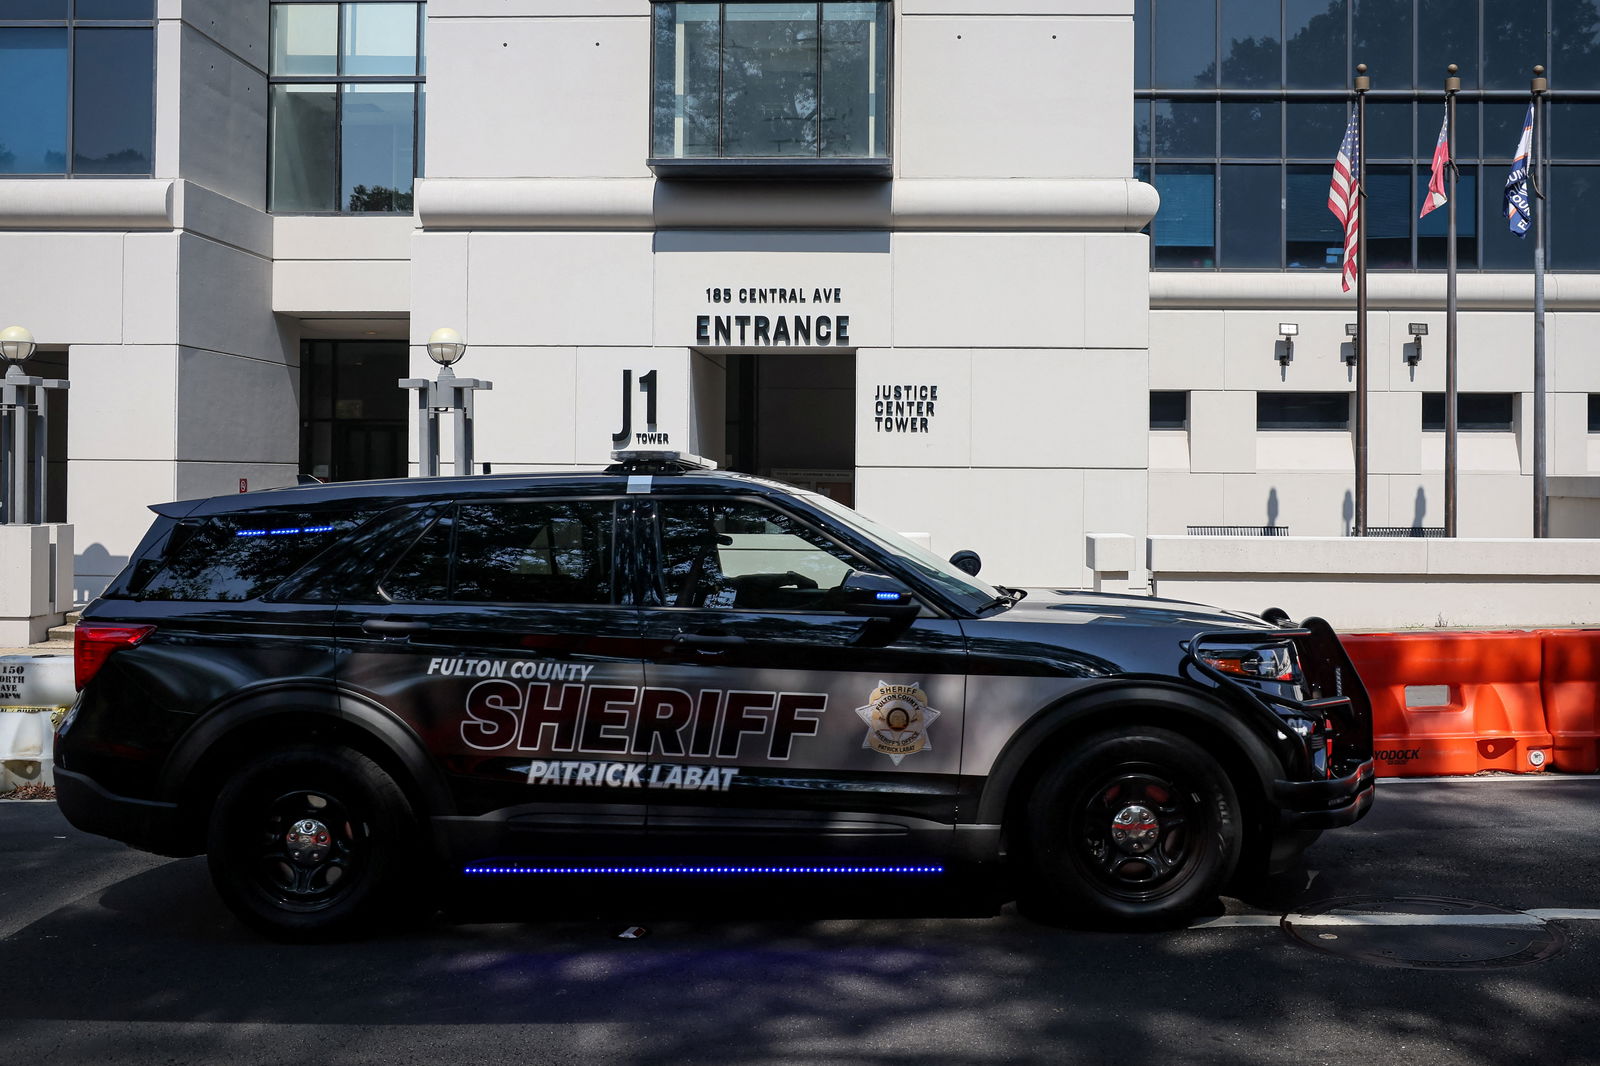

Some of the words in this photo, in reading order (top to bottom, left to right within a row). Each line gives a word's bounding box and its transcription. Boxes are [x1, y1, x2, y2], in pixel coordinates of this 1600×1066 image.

[705, 288, 732, 303] 185
[739, 288, 806, 304] CENTRAL
[813, 288, 841, 304] AVE
[696, 315, 850, 345] ENTRANCE
[875, 385, 938, 401] JUSTICE
[612, 369, 657, 445] J1
[875, 401, 935, 417] CENTER
[875, 417, 929, 433] TOWER
[636, 432, 669, 445] TOWER
[2, 665, 24, 675] 150
[427, 658, 507, 678] FULTON
[510, 660, 594, 682] COUNTY
[0, 684, 17, 692] AVE
[880, 686, 918, 695] SHERIFF
[875, 694, 897, 711] FULTON
[897, 694, 920, 711] COUNTY
[460, 679, 829, 760] SHERIFF
[901, 730, 920, 746] OFFICE
[878, 744, 899, 752] PATRICK
[899, 745, 915, 753] LABAT
[1374, 747, 1421, 761] YODOCK
[527, 760, 646, 788] PATRICK
[648, 764, 740, 792] LABAT
